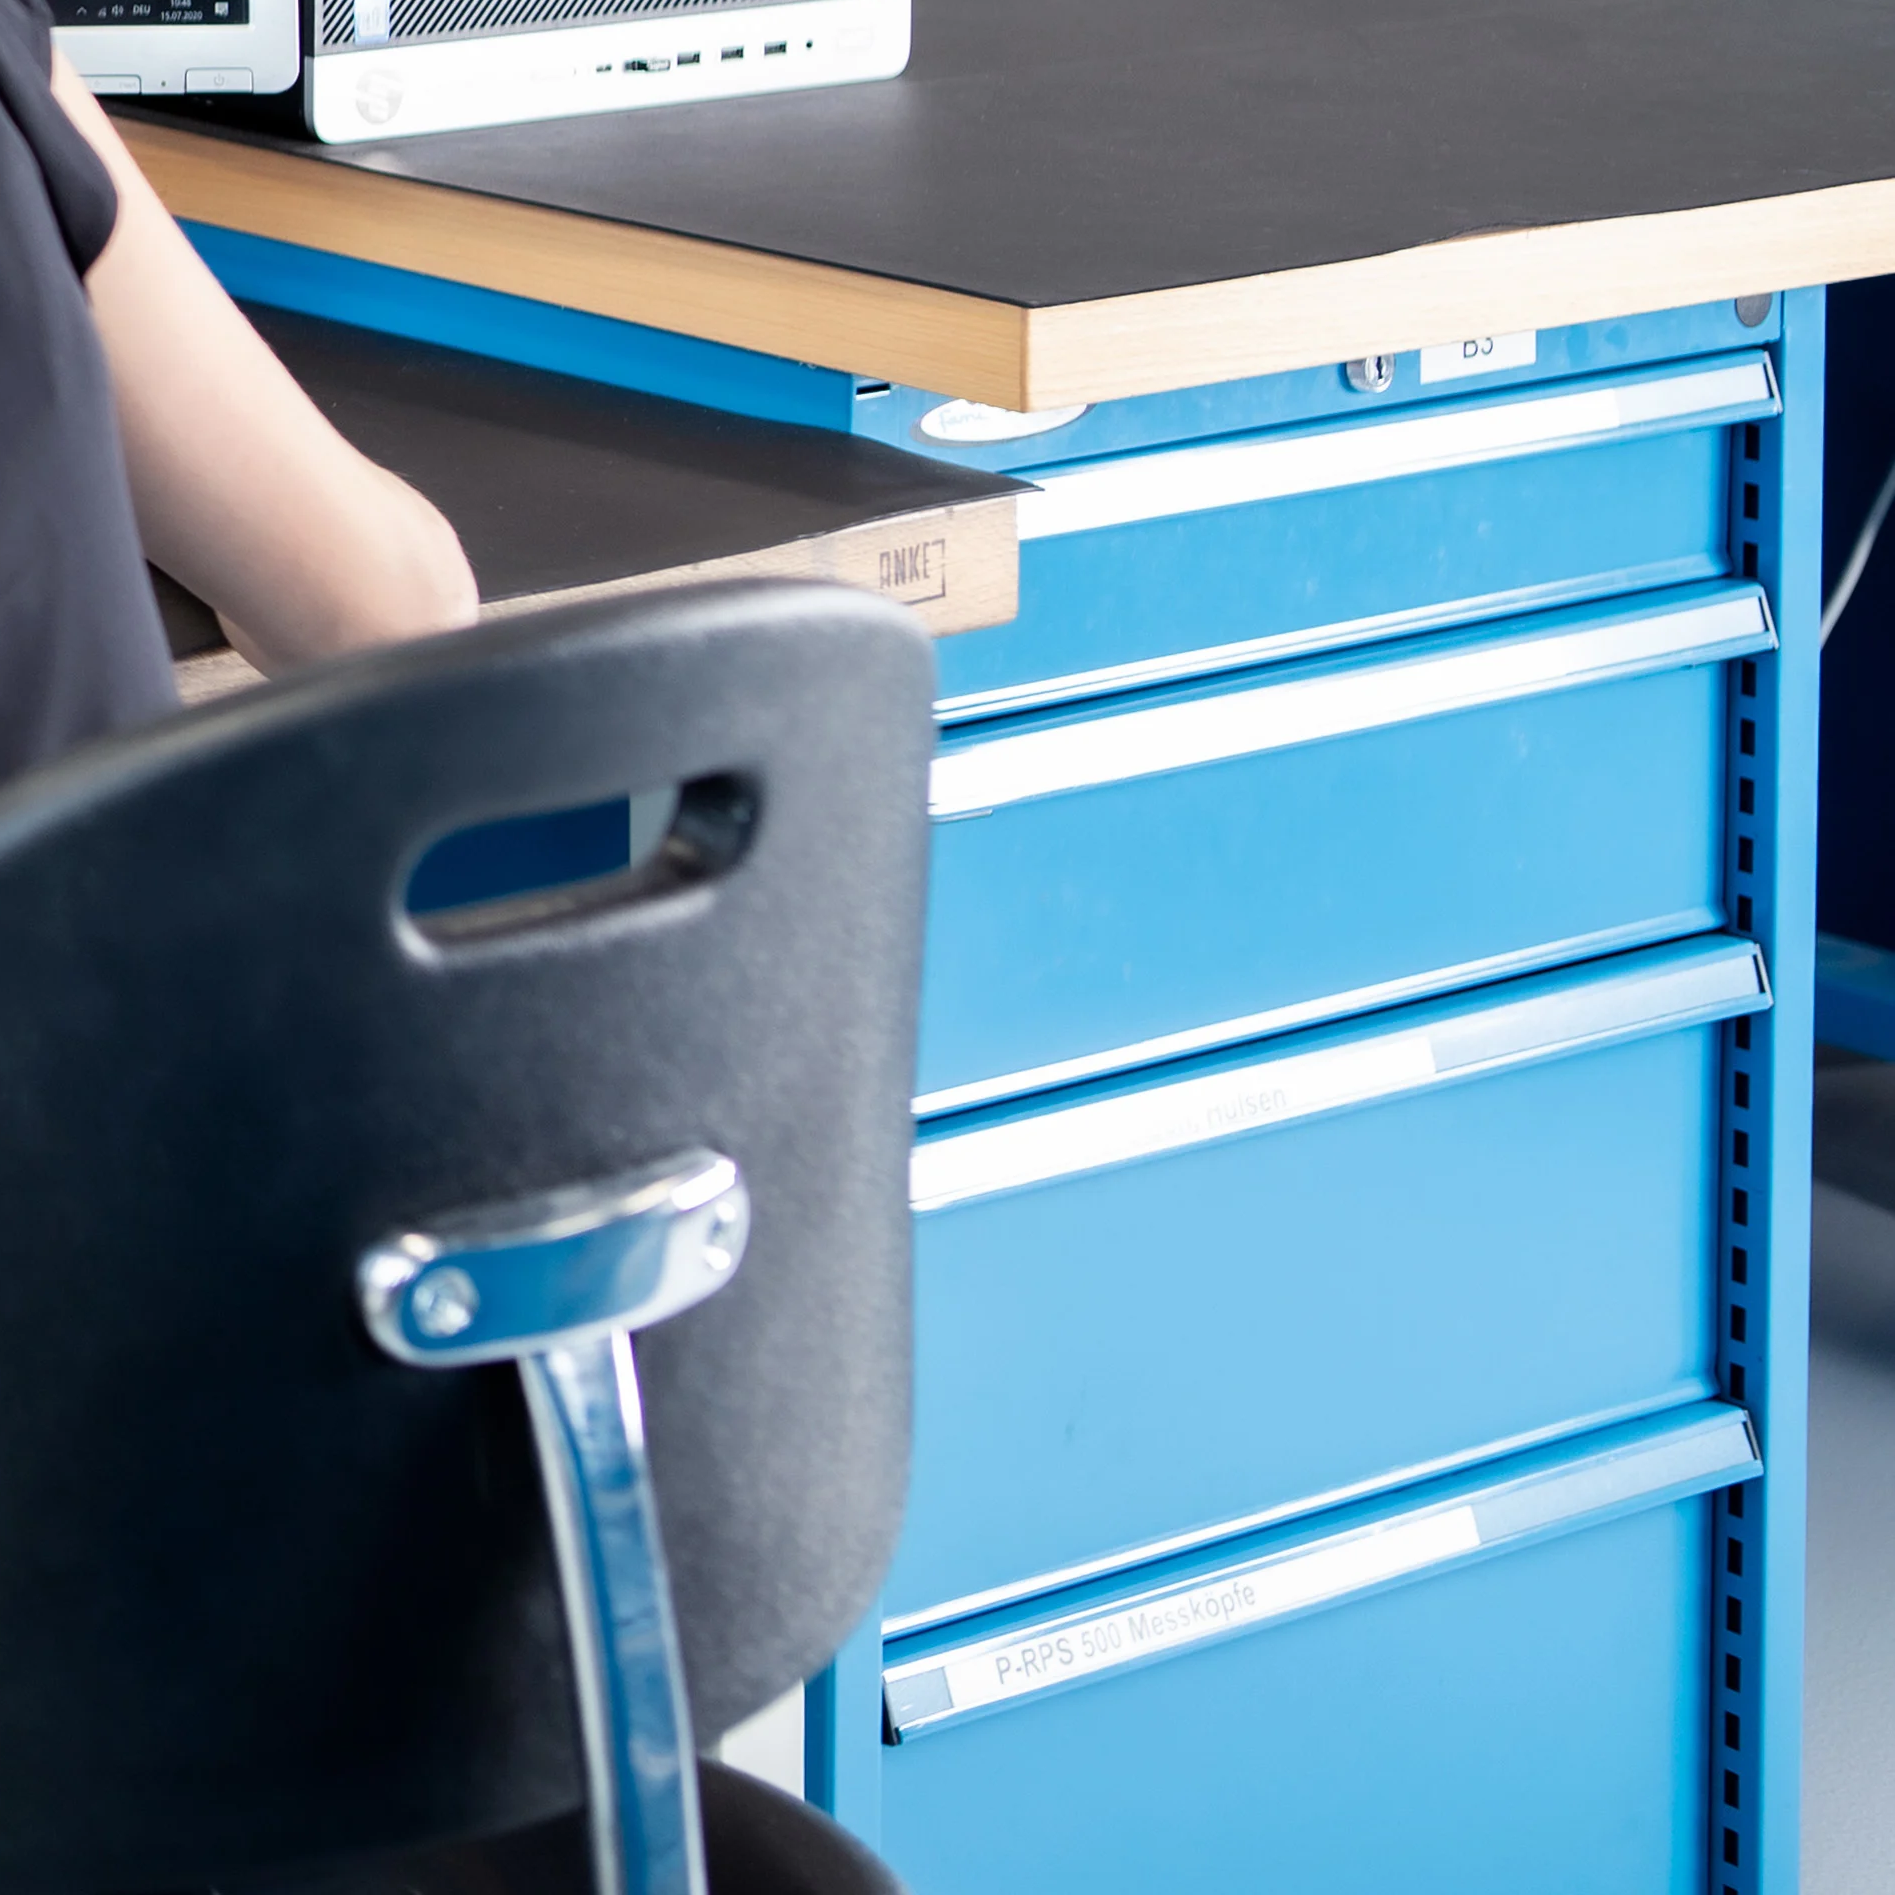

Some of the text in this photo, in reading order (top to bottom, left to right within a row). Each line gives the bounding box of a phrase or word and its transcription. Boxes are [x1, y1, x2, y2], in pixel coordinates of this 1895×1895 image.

[132, 4, 152, 16] DEU
[160, 10, 203, 22] 15.07.2020
[995, 1580, 1257, 1686] P-RPS 500 Messköpfe
